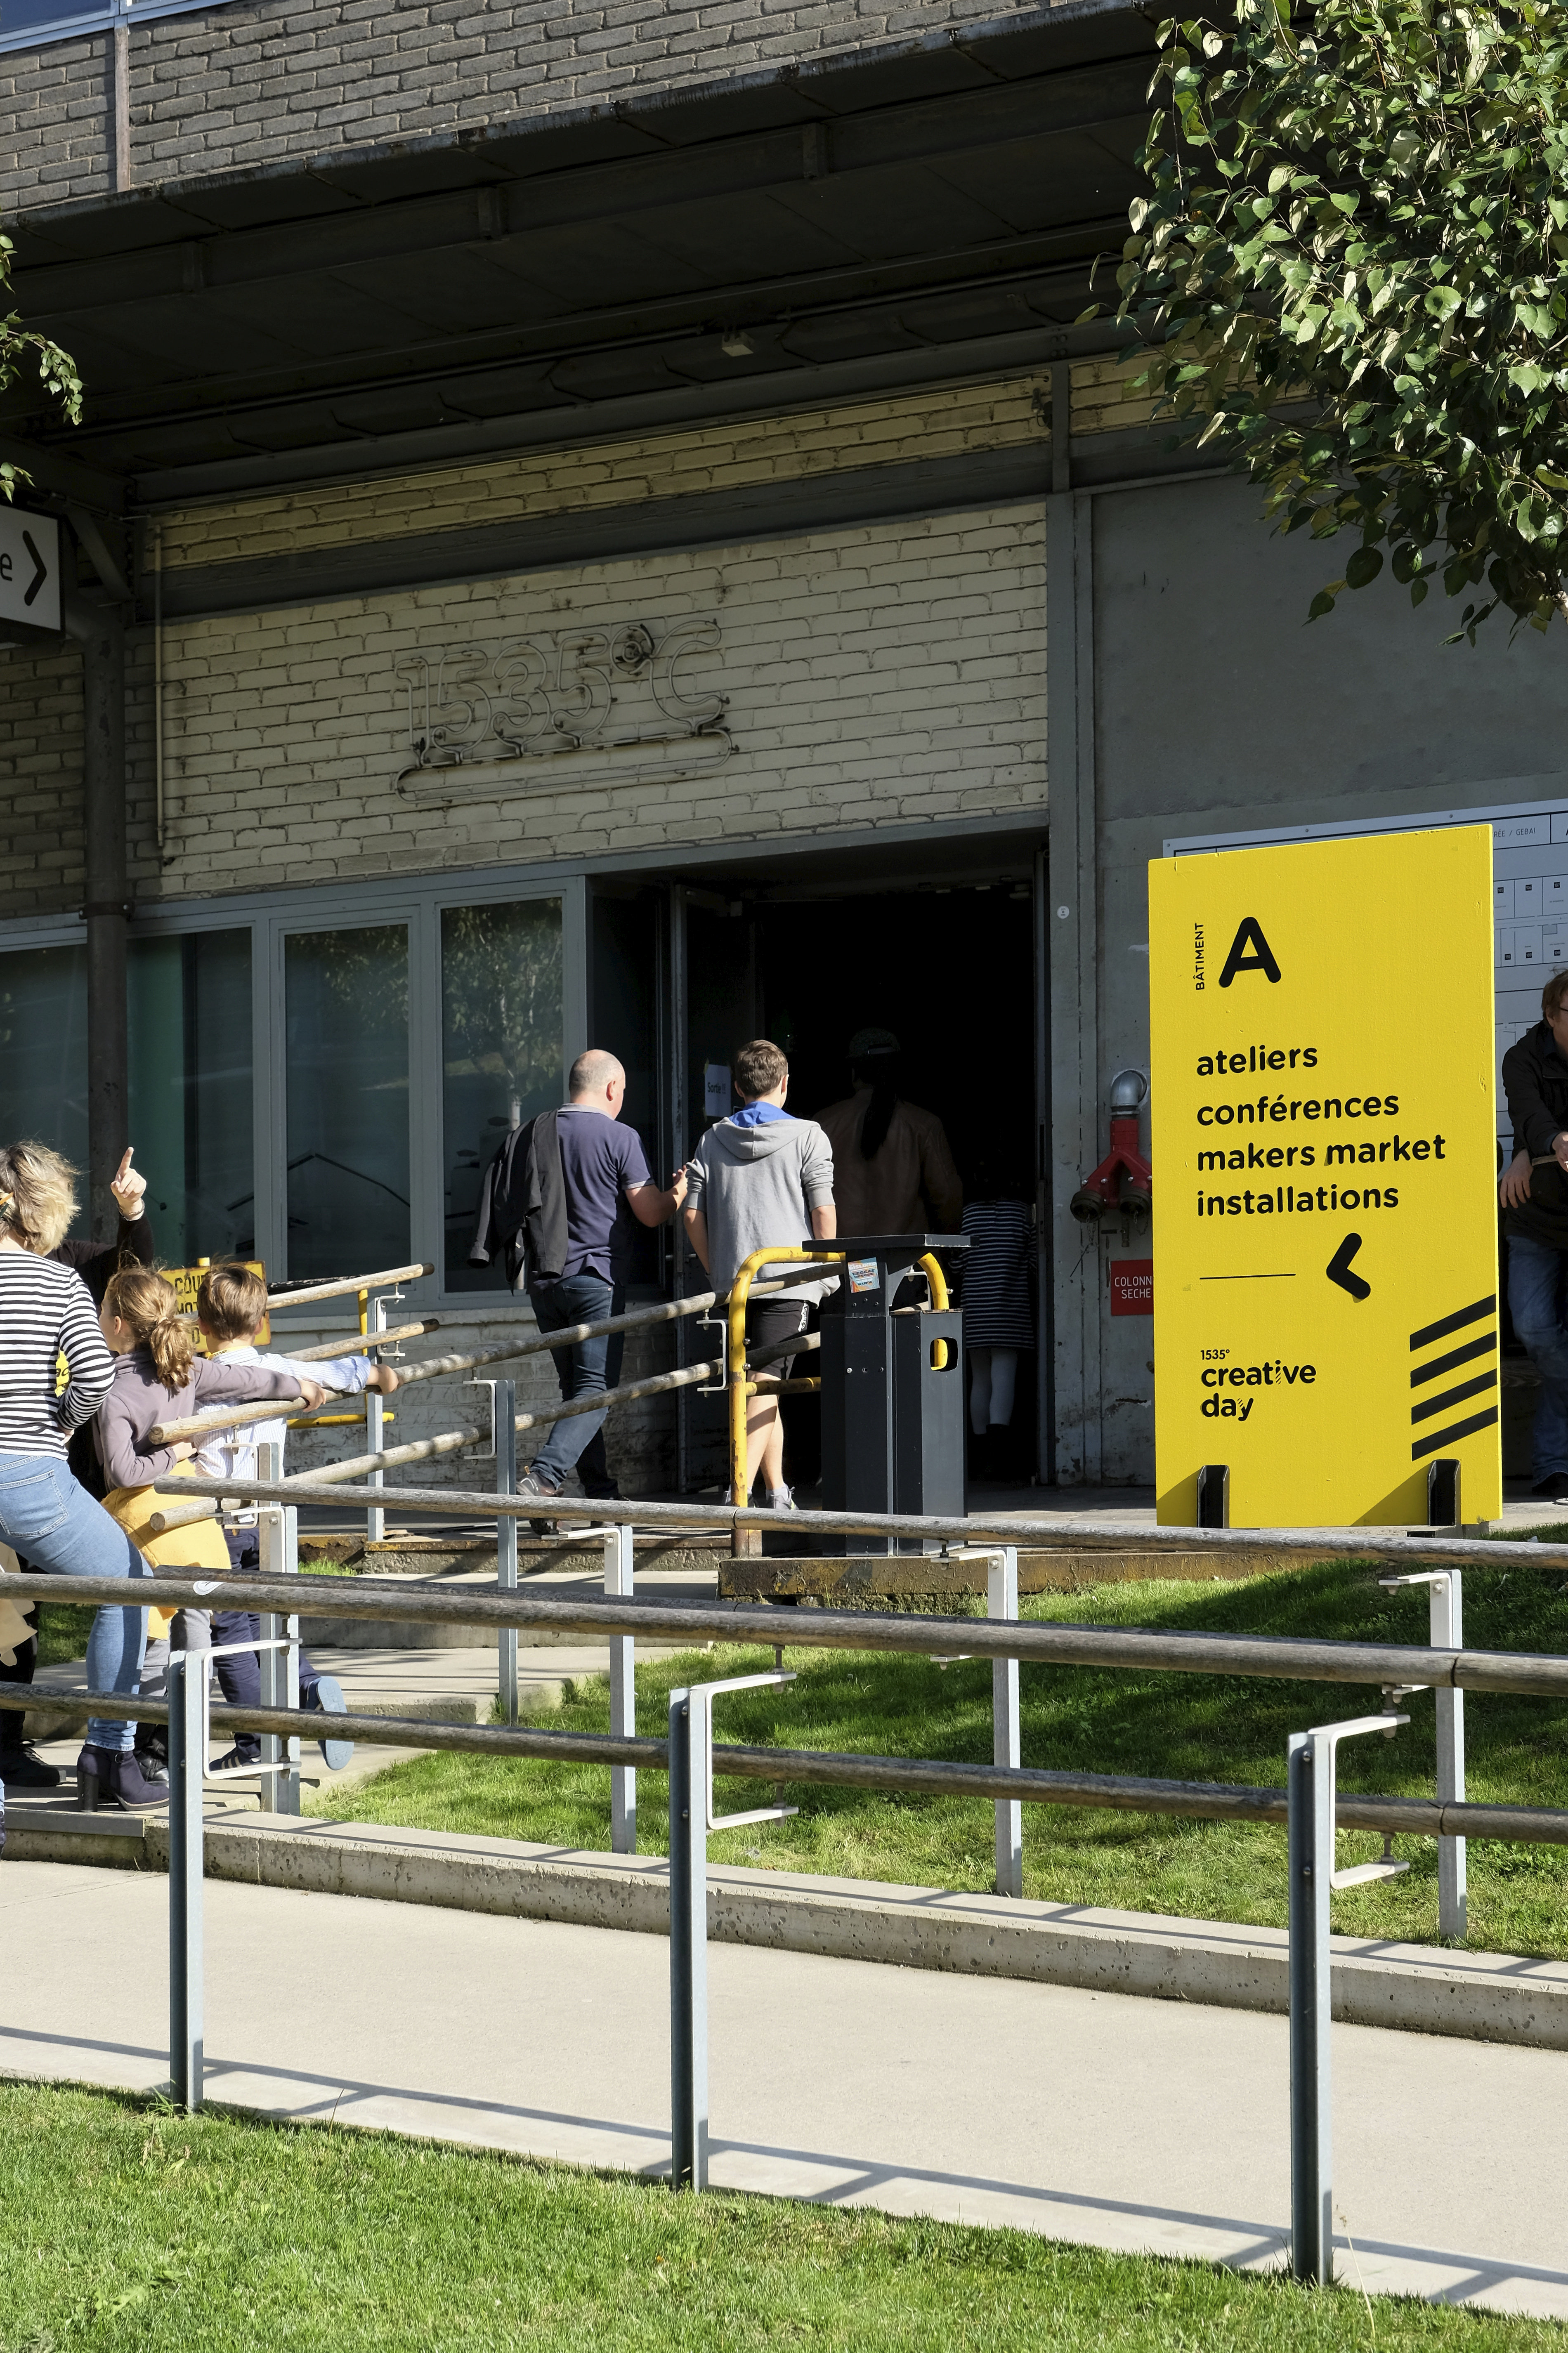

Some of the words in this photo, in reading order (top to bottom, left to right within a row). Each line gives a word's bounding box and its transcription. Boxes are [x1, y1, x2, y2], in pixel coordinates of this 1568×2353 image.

[1193, 923, 1205, 990] BÂTIMENT
[1219, 917, 1281, 988] A
[1197, 1045, 1318, 1076] ateliers
[707, 1082, 721, 1094] Sortie
[1197, 1094, 1399, 1126] conférences
[1198, 1142, 1315, 1171] makers
[1327, 1134, 1446, 1165] market
[1197, 1184, 1398, 1216] installations
[1115, 1276, 1153, 1287] COLONN
[1122, 1288, 1151, 1299] SECHE
[1200, 1349, 1230, 1360] 1535°
[1201, 1359, 1316, 1387] creative
[1200, 1392, 1254, 1421] day
